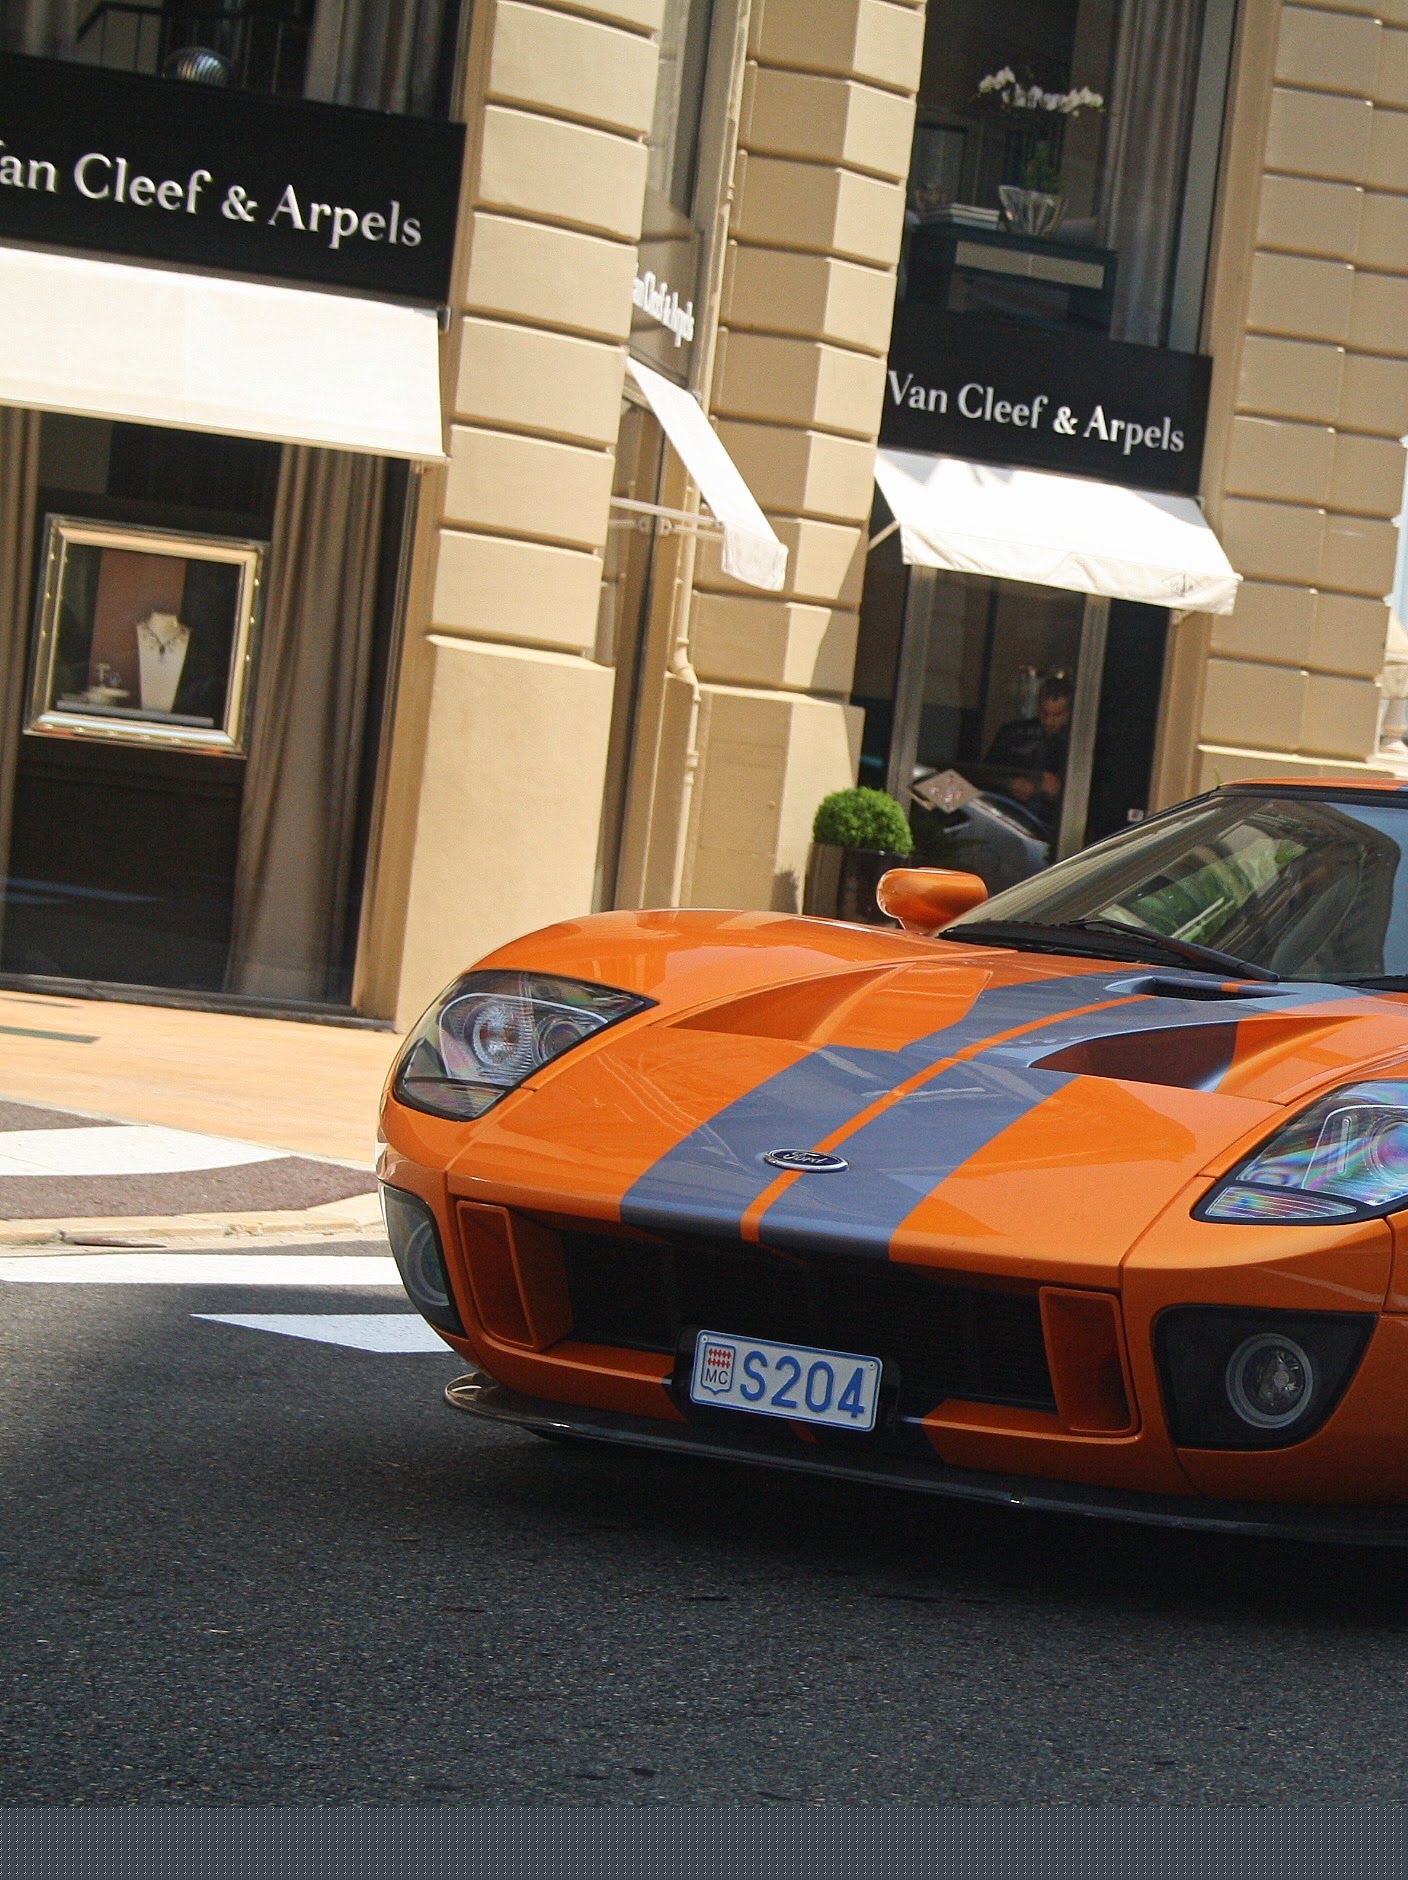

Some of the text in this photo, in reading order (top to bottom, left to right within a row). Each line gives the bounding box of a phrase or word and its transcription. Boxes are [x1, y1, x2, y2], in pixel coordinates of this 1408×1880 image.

[0, 140, 422, 250] an Cleef & Arpels
[887, 369, 1186, 456] Van Cleef & Arpels
[783, 1151, 829, 1164] Ford
[705, 1369, 729, 1385] MC
[739, 1350, 865, 1419] S204
